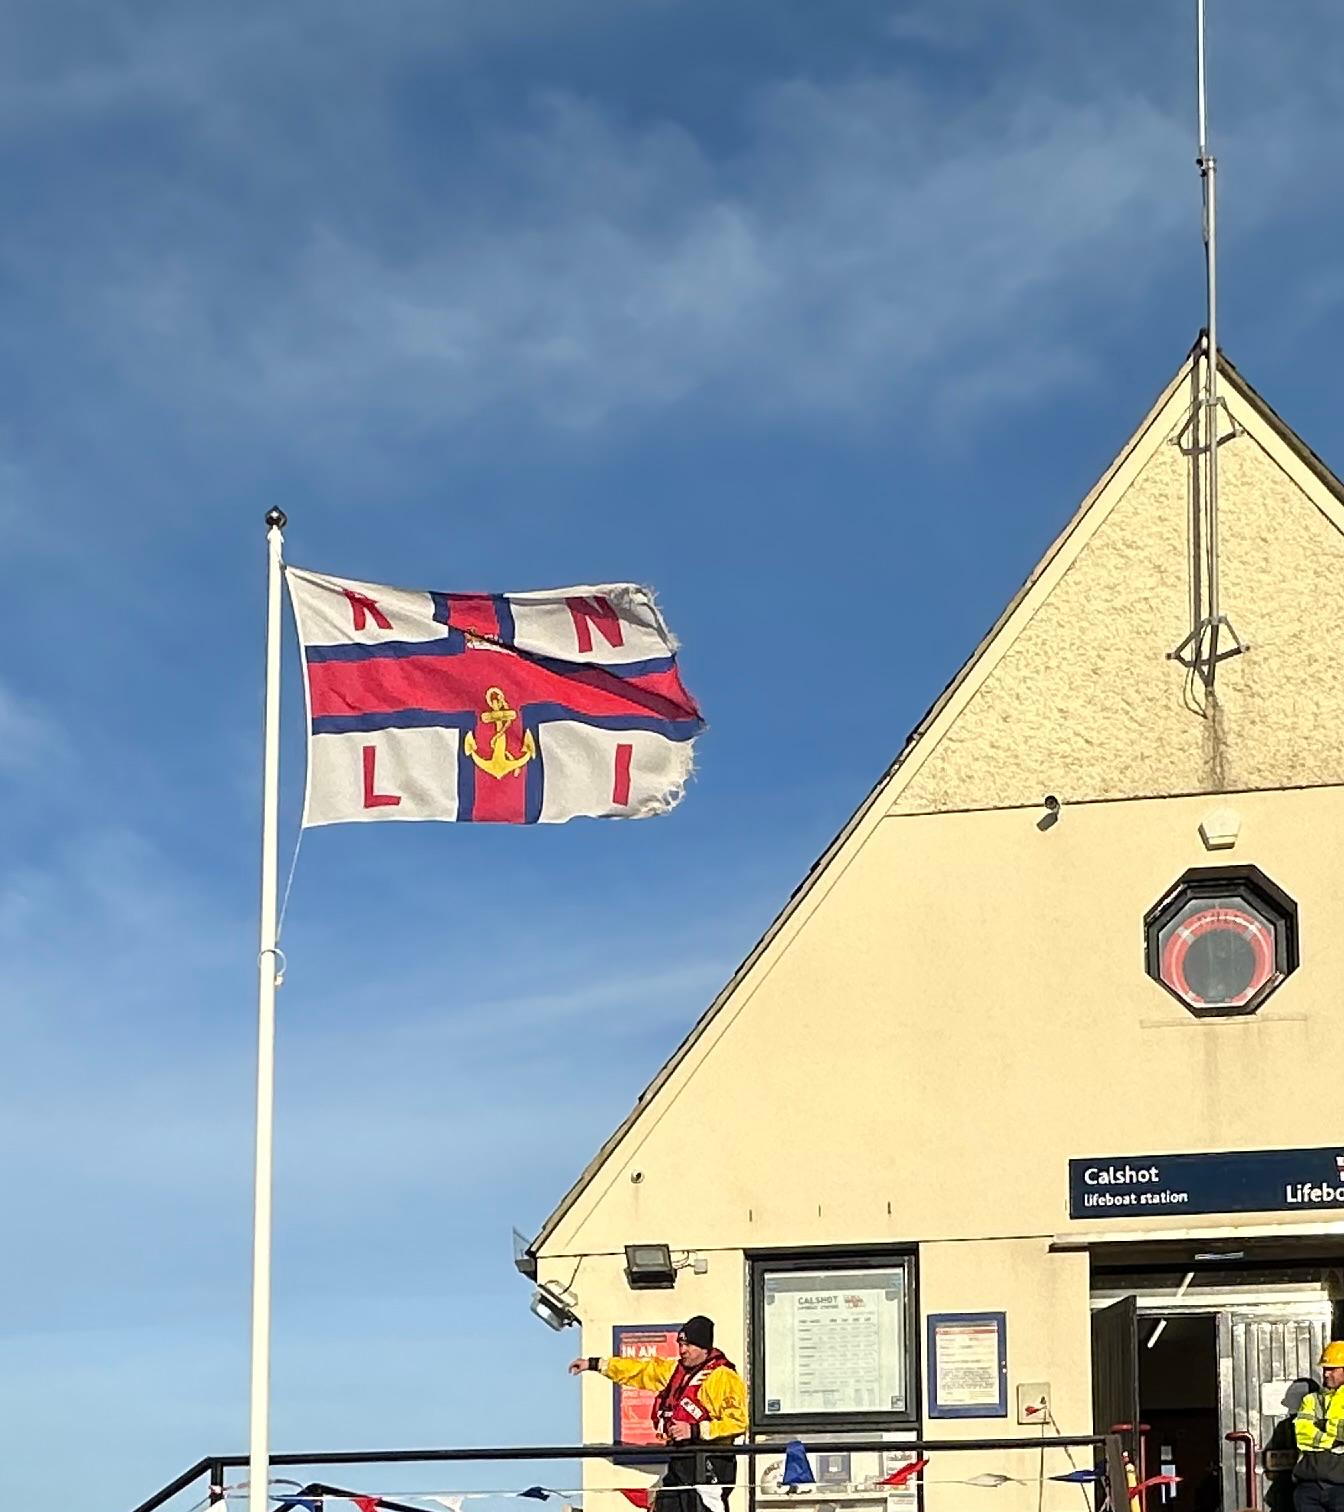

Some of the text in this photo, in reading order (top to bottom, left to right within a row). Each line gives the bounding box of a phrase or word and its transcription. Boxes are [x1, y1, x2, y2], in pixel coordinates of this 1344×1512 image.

[564, 596, 625, 653] N
[363, 744, 632, 808] L I
[1084, 1165, 1160, 1185] Calshot
[1140, 1190, 1189, 1205] station
